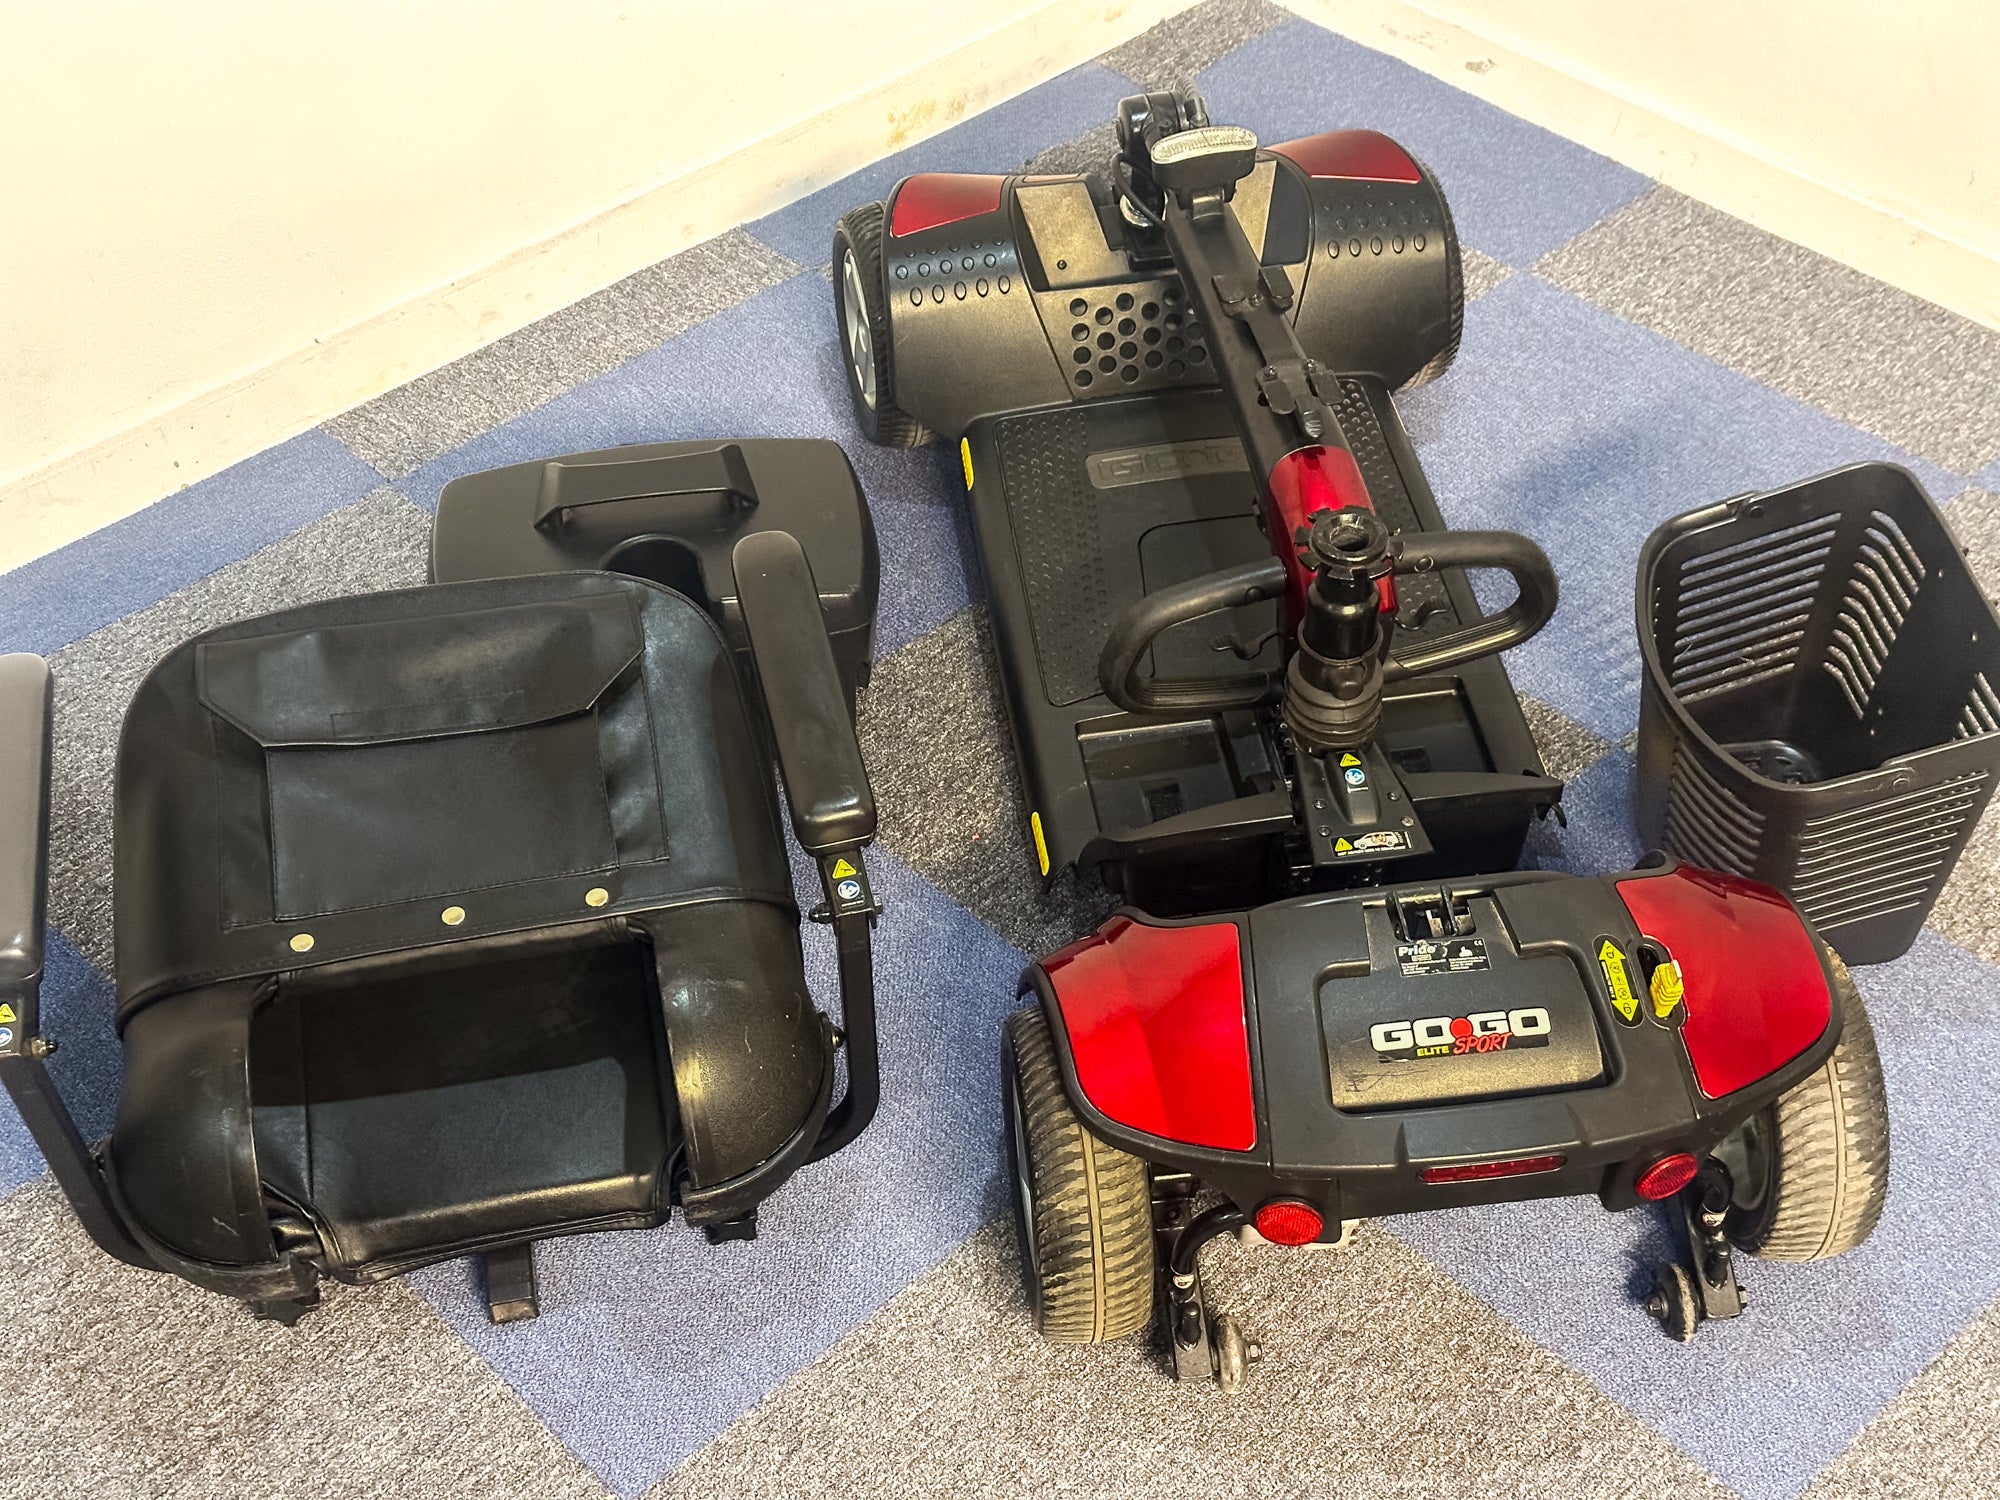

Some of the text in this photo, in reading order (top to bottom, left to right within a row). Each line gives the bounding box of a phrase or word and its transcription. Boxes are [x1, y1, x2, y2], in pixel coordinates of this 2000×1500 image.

[1398, 944, 1436, 957] Pride
[1453, 1032, 1513, 1056] SPORT
[1416, 1045, 1450, 1057] ELITE
